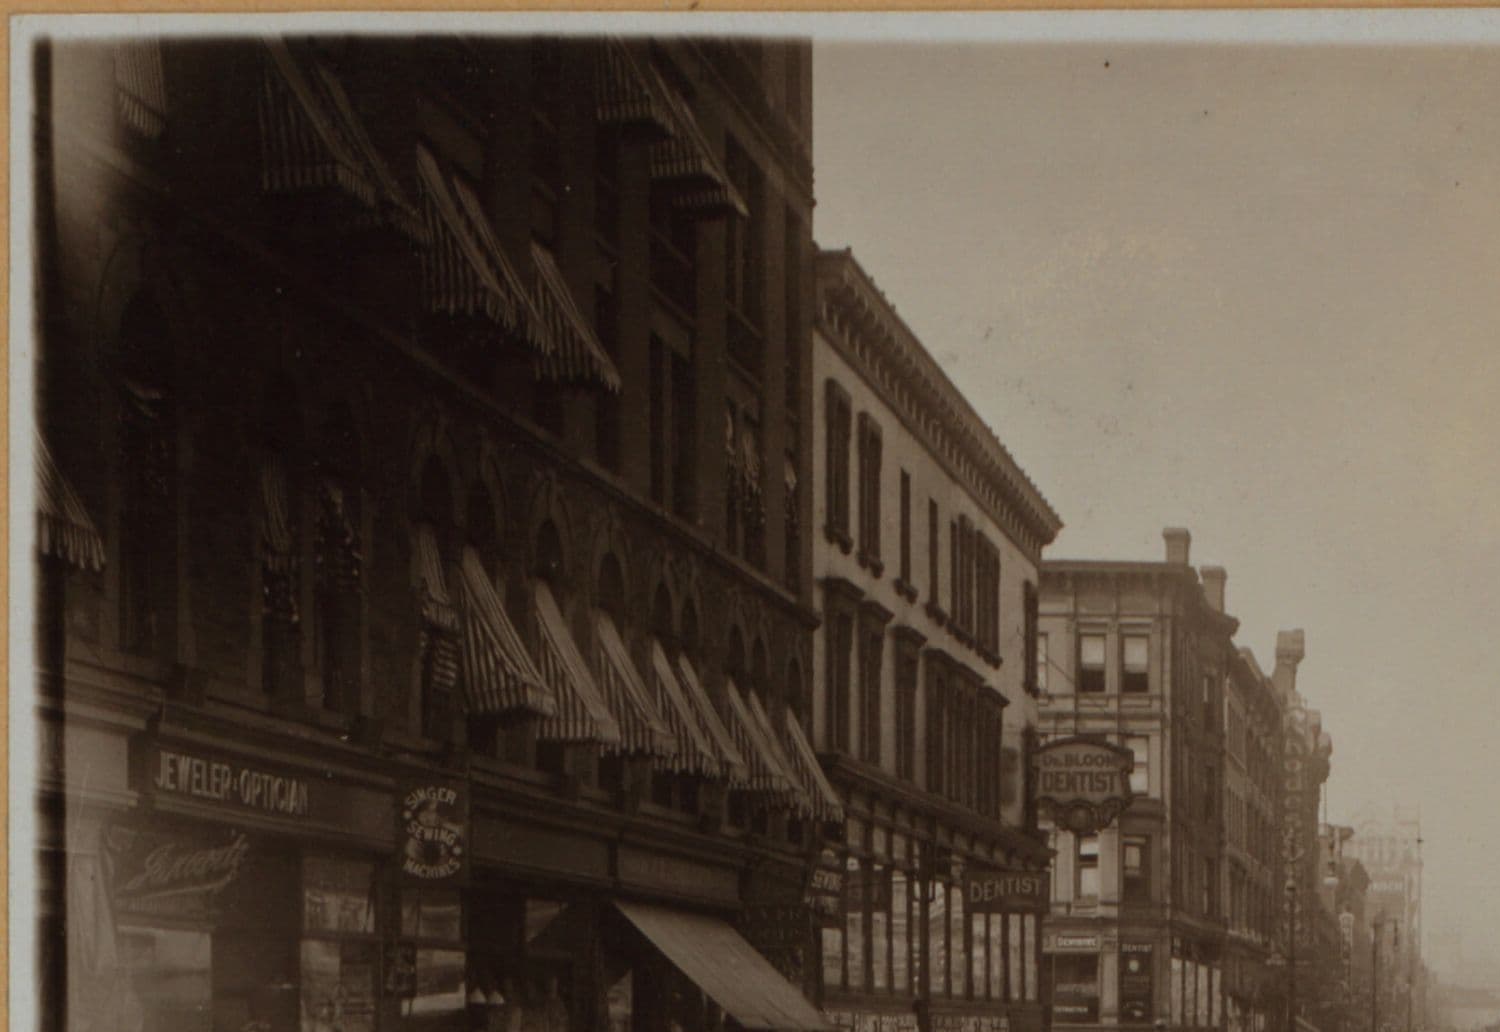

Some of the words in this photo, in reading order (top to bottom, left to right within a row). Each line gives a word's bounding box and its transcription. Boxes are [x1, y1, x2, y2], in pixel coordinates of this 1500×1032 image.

[1041, 771, 1116, 793] DENTIST
[403, 785, 458, 811] SINGER
[405, 820, 457, 847] SEWING
[969, 876, 1042, 903] DENTIST
